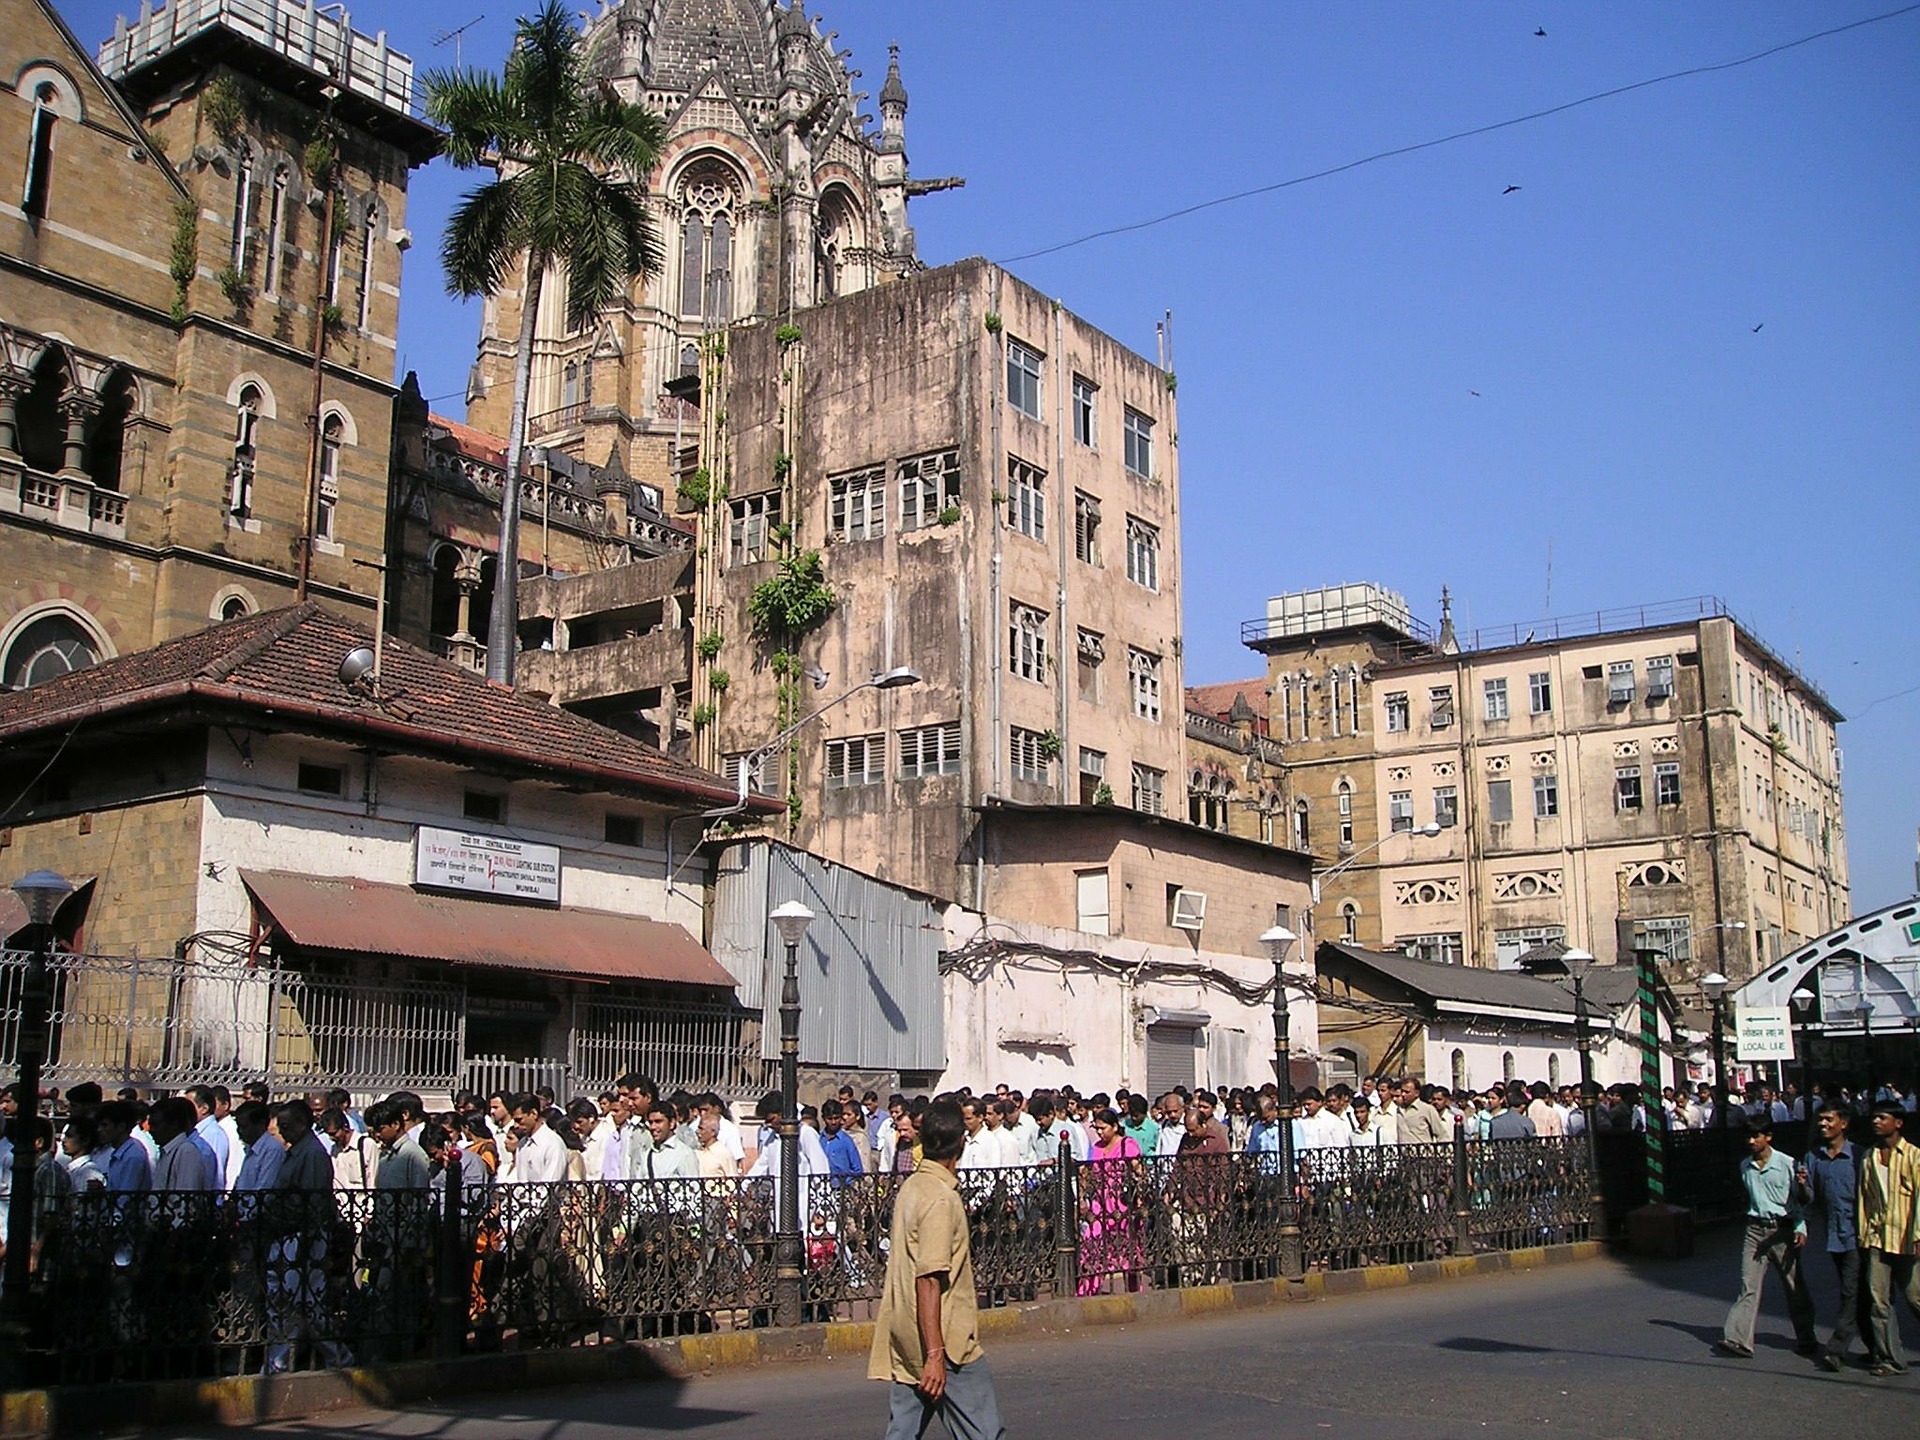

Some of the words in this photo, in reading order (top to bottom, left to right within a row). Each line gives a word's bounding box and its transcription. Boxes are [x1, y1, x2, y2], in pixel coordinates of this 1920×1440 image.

[485, 839, 504, 849] CENTRAL
[515, 884, 540, 894] MUMBAI
[1743, 1042, 1767, 1051] LOCAL
